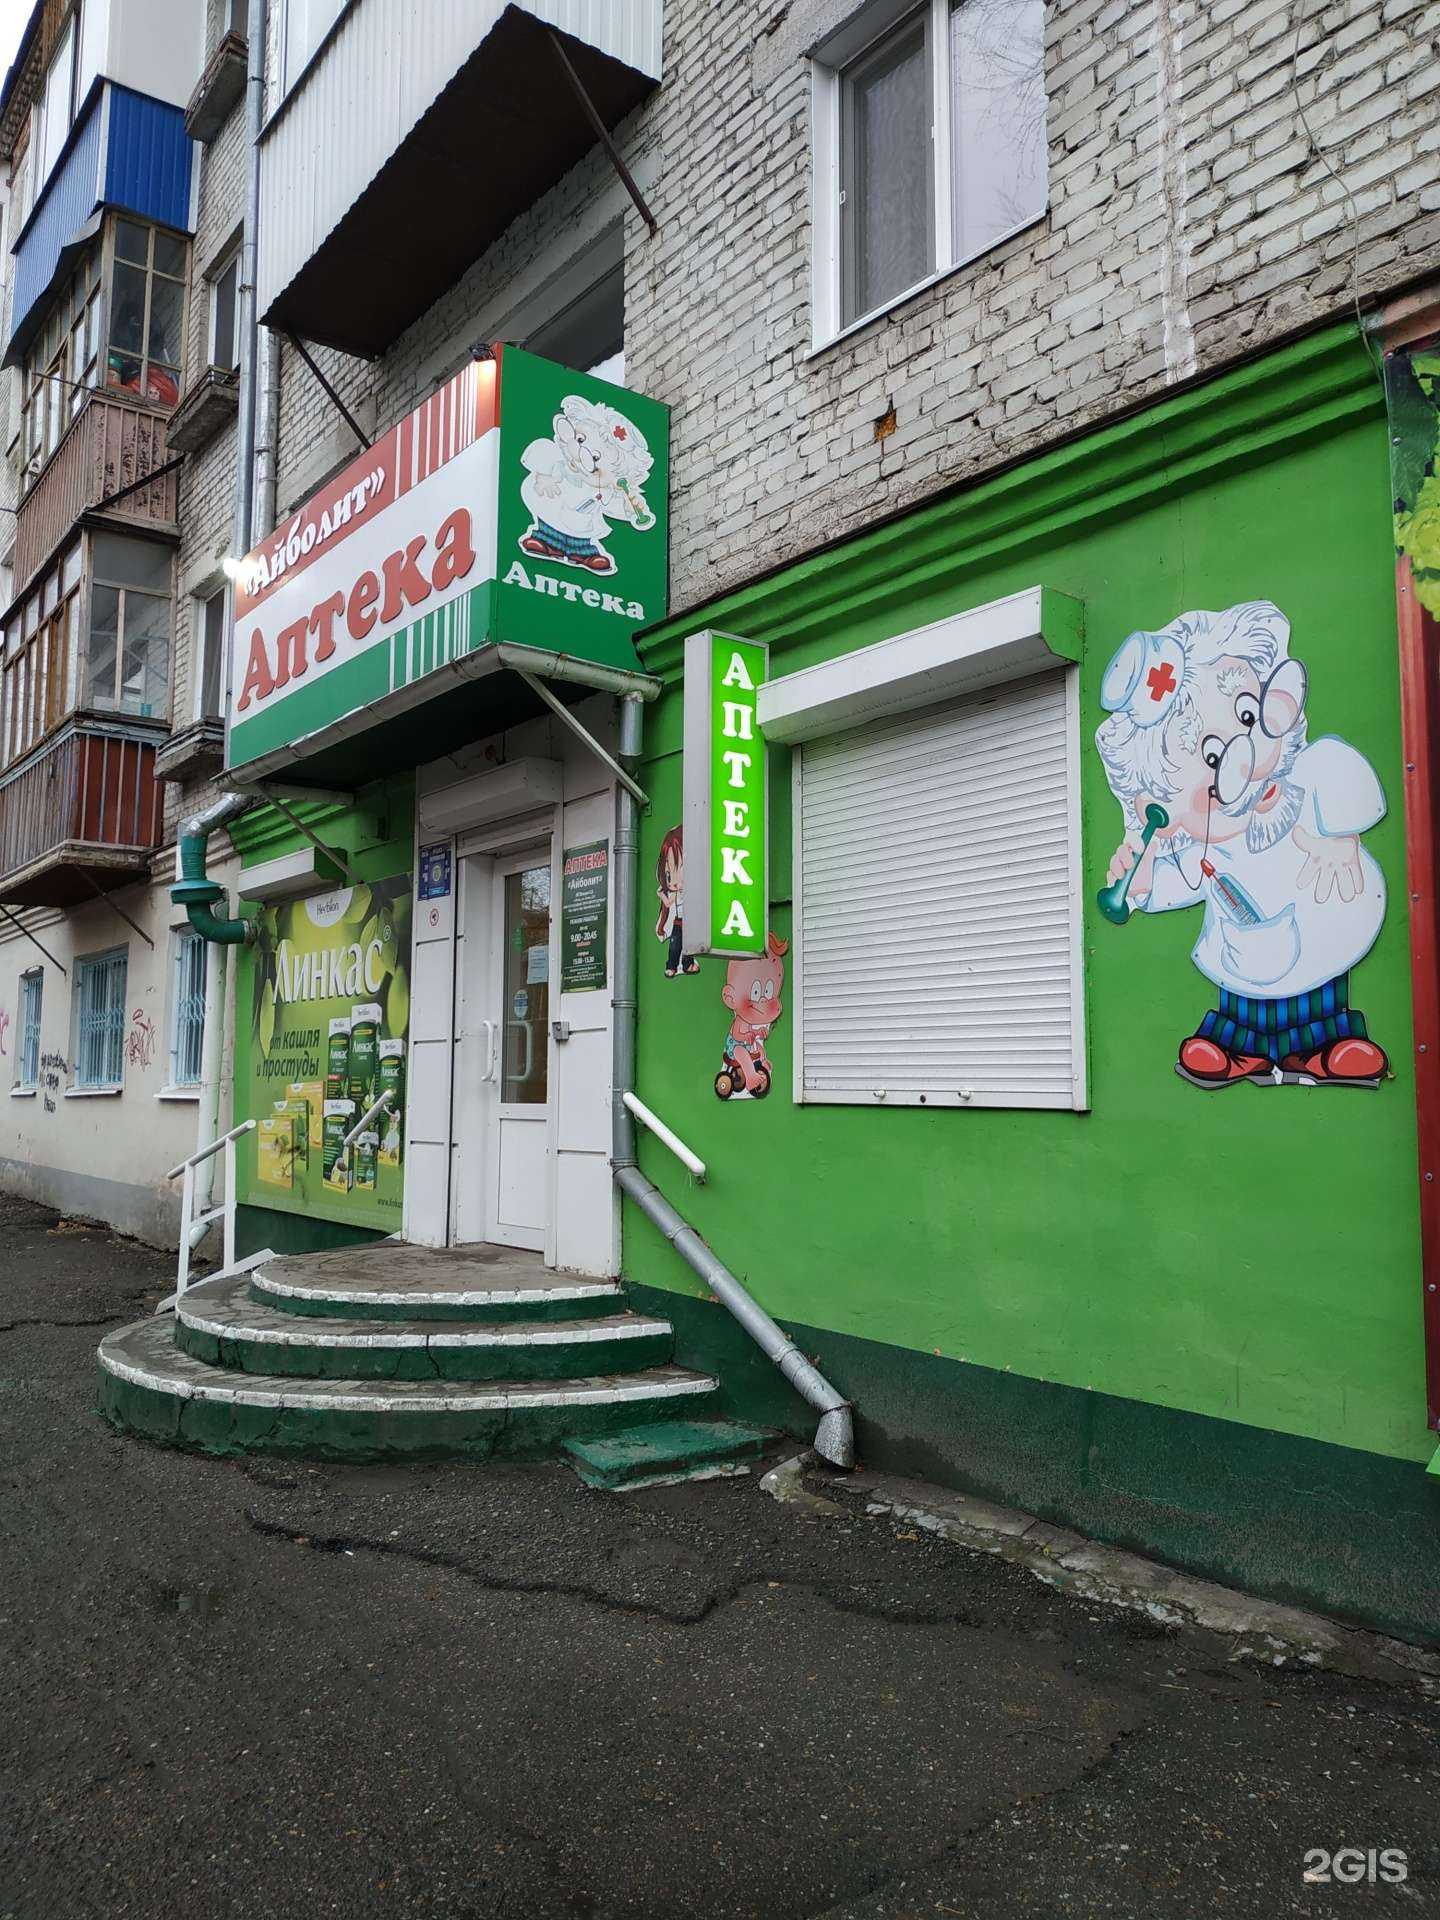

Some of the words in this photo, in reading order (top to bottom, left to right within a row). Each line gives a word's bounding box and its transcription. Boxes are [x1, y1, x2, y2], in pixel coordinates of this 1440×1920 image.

[244, 466, 386, 596] «Айболит»
[237, 507, 476, 712] Аптека
[503, 561, 646, 621] Аптека
[720, 652, 755, 937] АПТЕКА
[564, 850, 607, 875] АПТЕКА
[263, 1050, 320, 1084] простуды
[282, 1029, 321, 1050] кашля
